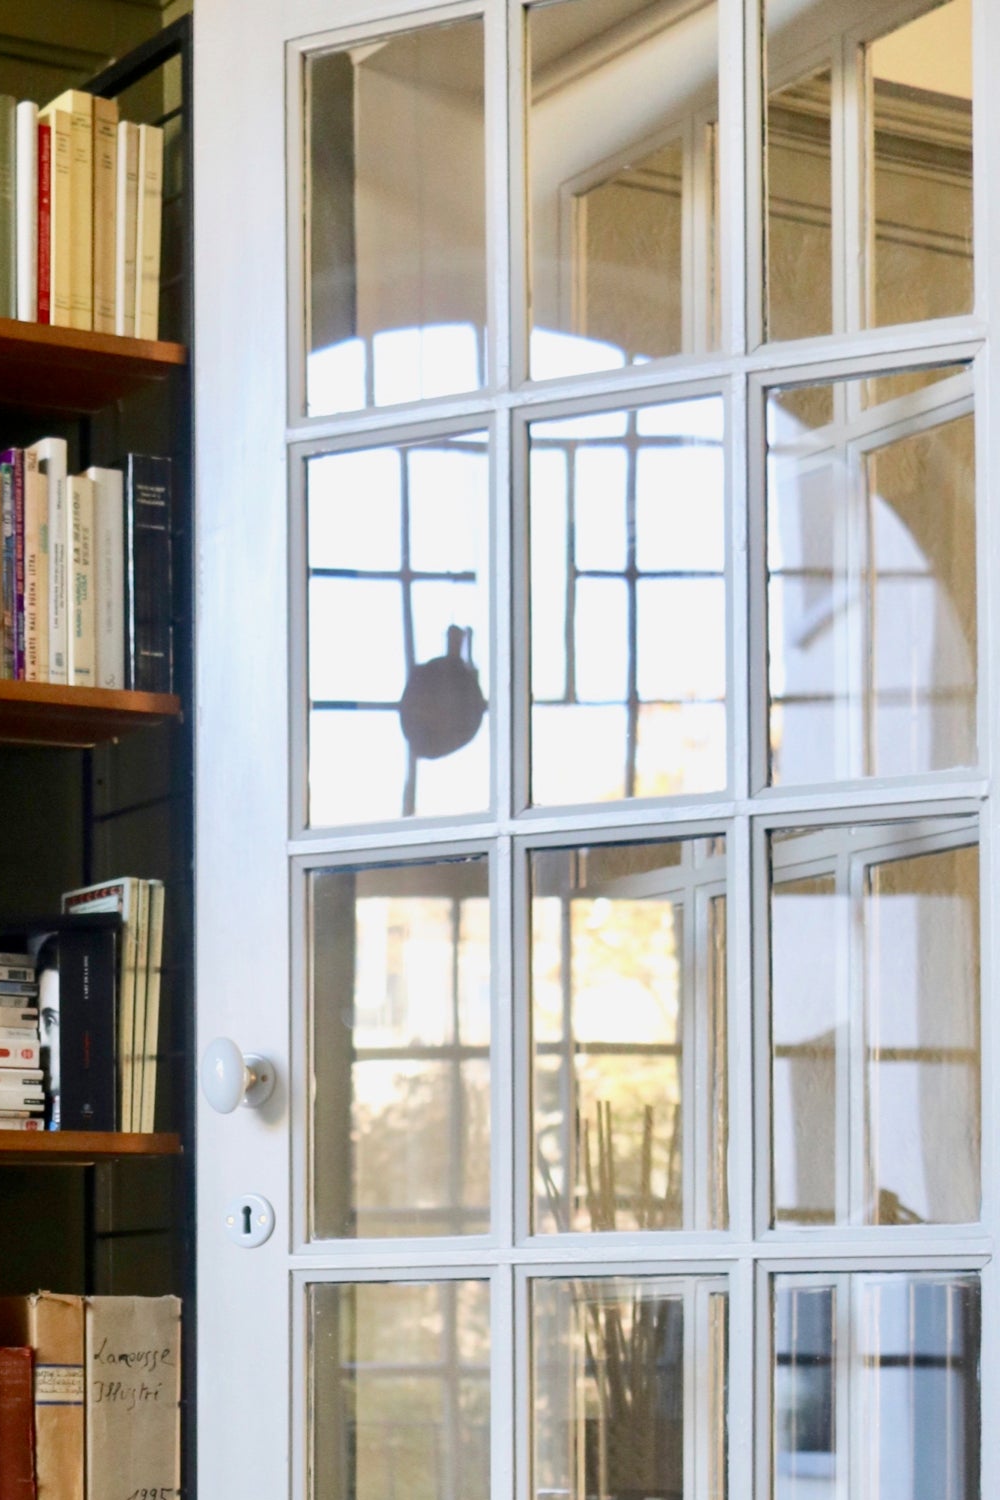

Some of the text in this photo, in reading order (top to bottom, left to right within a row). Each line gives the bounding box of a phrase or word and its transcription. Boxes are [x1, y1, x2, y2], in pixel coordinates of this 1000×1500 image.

[73, 492, 81, 565] LA MAISON
[28, 553, 36, 576] LETRA
[28, 612, 36, 631] HACE
[28, 637, 36, 666] MUERTE
[93, 1337, 174, 1371] Larousse
